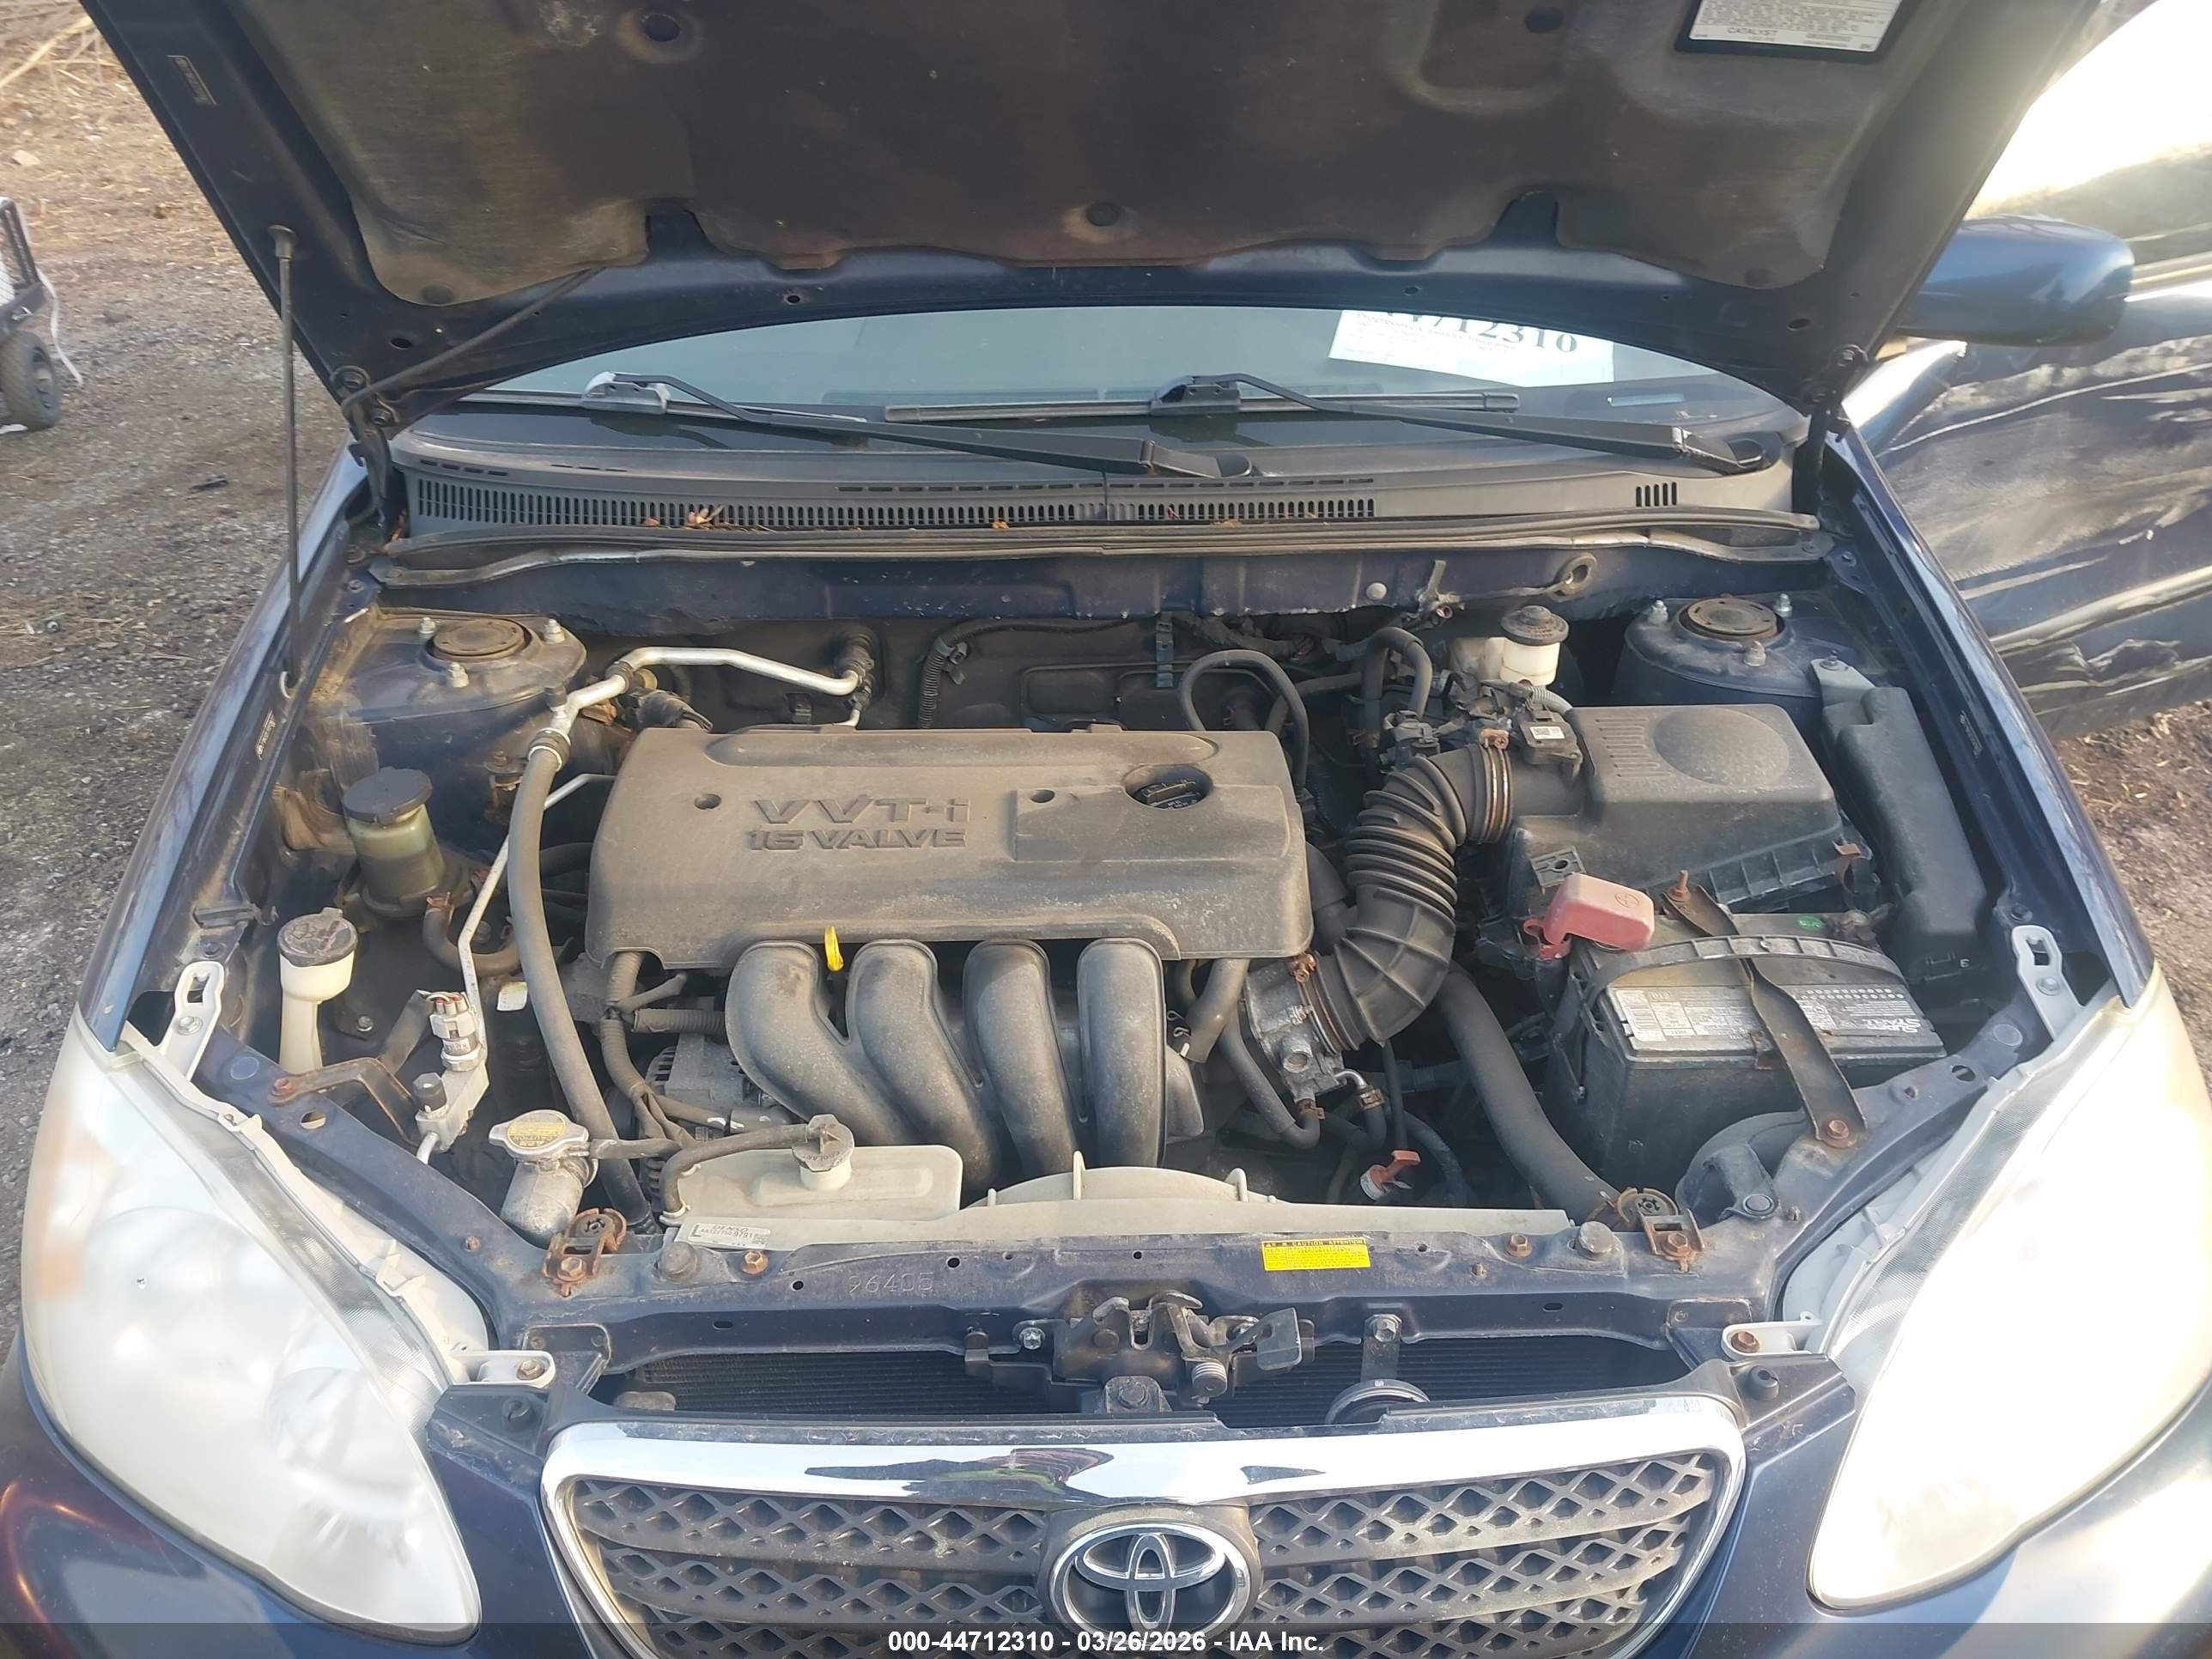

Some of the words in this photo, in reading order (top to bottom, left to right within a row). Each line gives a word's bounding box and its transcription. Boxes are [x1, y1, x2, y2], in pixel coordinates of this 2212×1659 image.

[1727, 27, 1778, 37] CATALYST
[750, 830, 805, 851] 16
[809, 828, 968, 851] VALVE
[712, 1224, 750, 1233] DENSO
